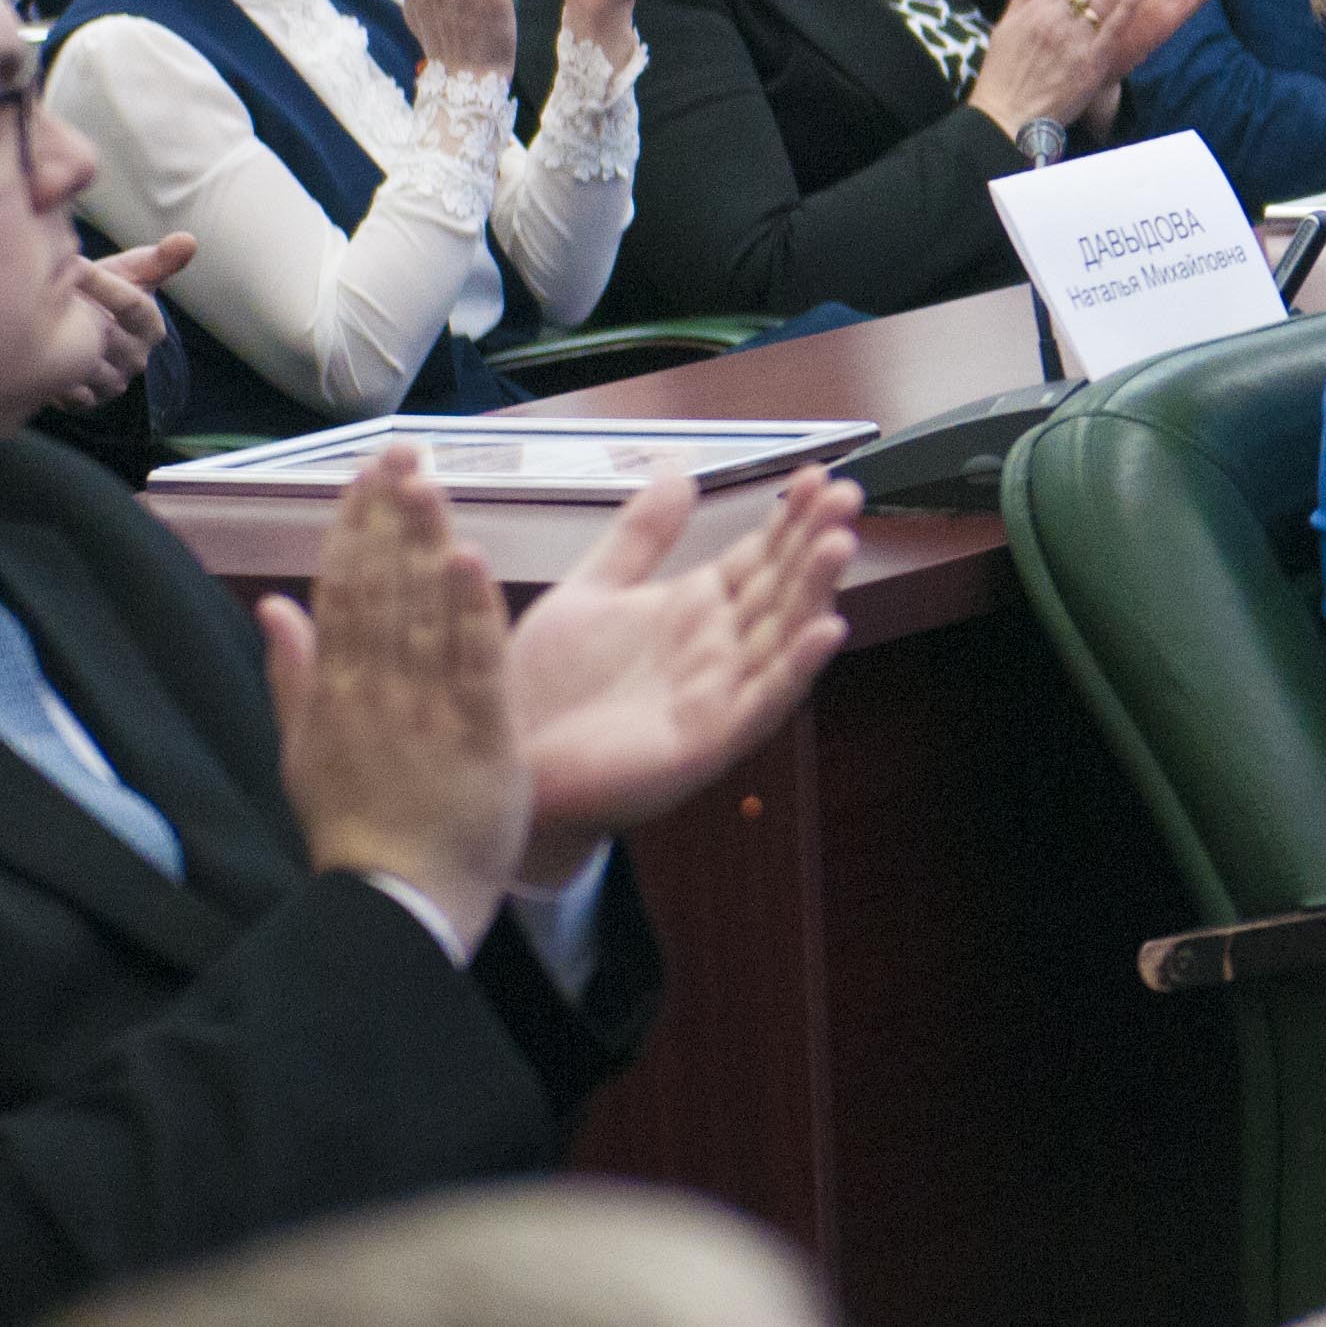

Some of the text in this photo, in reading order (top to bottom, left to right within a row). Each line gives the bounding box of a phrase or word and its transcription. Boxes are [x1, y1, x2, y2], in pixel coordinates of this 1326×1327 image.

[1078, 208, 1206, 273] ДАВЫДОВА
[1066, 245, 1248, 310] Наталья Михайловна
